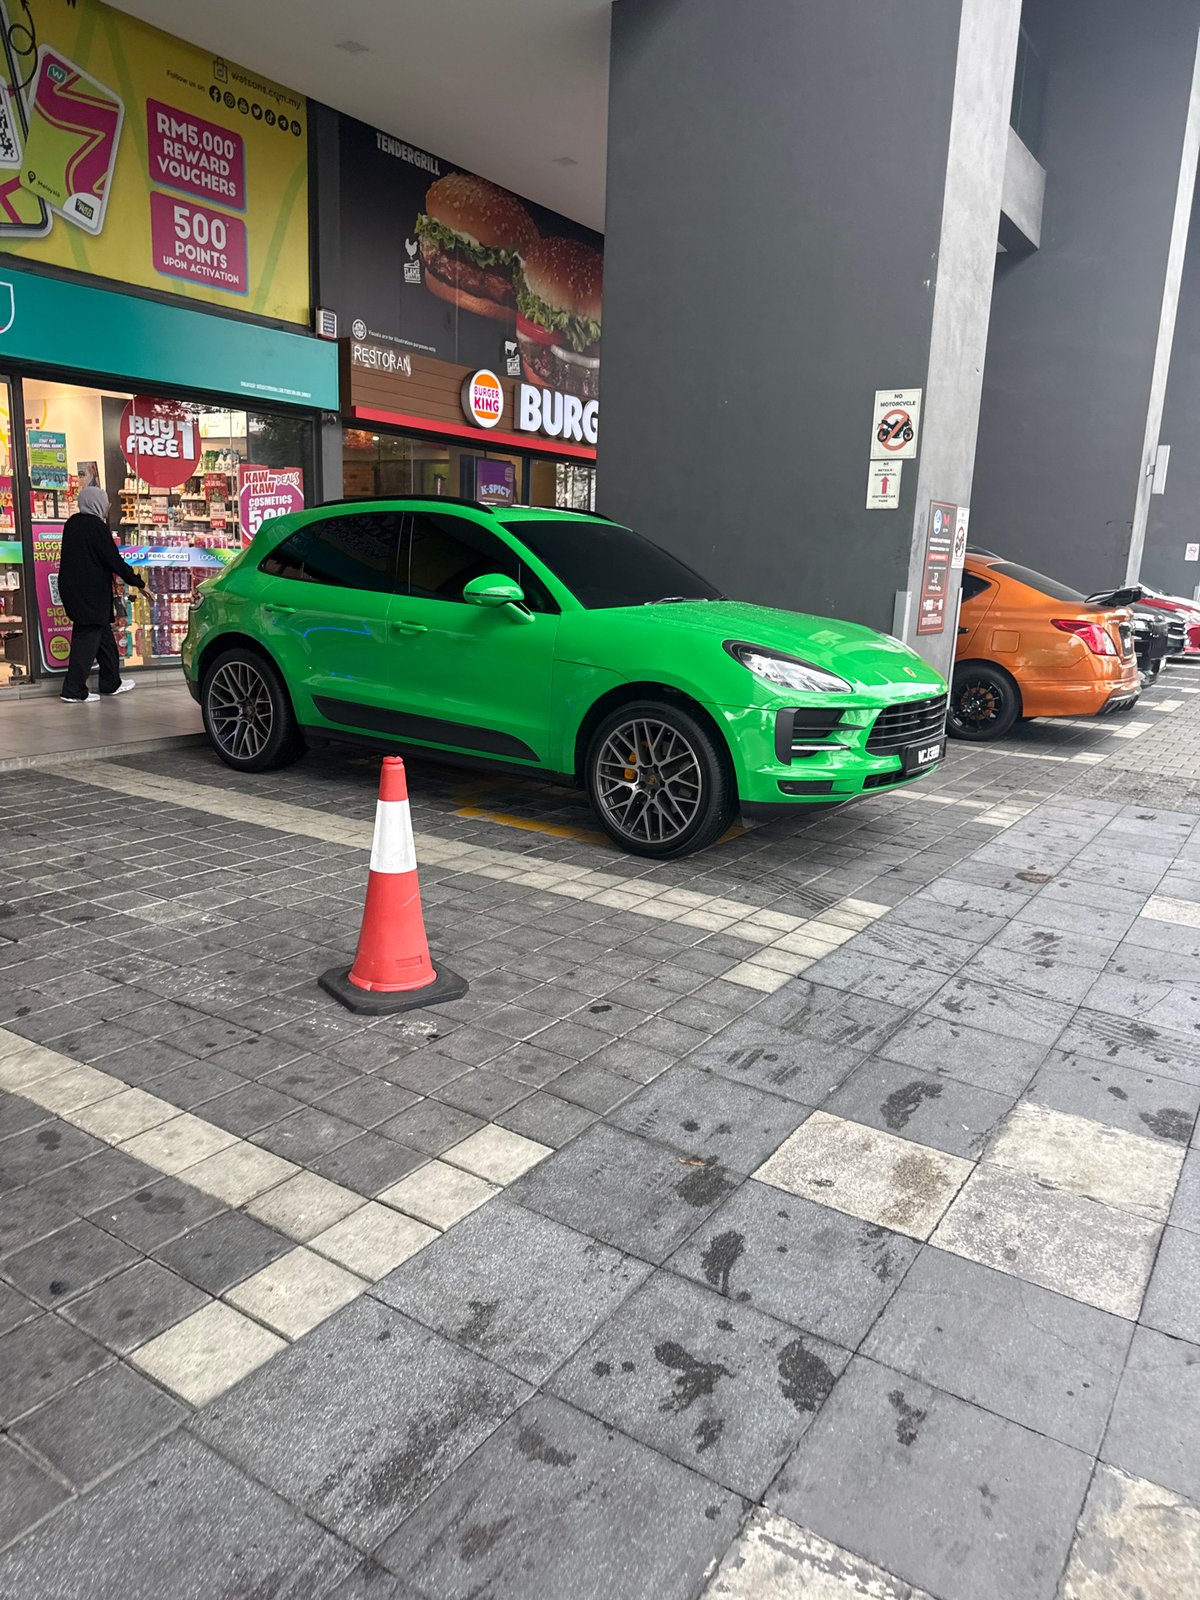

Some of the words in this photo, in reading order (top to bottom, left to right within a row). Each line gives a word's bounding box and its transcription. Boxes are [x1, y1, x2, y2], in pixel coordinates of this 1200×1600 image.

[166, 69, 188, 84] Follow
[189, 80, 196, 88] us
[197, 84, 206, 92] on
[231, 71, 302, 110] watsons.com.my
[163, 138, 229, 176] REWARD
[376, 132, 440, 176] TENDERGRILL
[37, 180, 60, 198] Malaysia
[157, 155, 236, 197] VOUCHERS
[174, 205, 227, 250] 500
[175, 240, 227, 269] POINTS
[163, 255, 187, 270] UPON
[190, 264, 239, 284] ACTIVATION
[354, 345, 411, 376] RESTORAN
[474, 386, 499, 399] BURGER
[474, 396, 499, 412] KING
[520, 383, 599, 444] BURG
[126, 435, 179, 458] FREE
[177, 421, 194, 460] 1
[245, 471, 269, 484] KAW
[276, 472, 299, 485] DEALS
[252, 482, 275, 495] KAW
[480, 484, 511, 498] K-SPICY
[249, 495, 293, 507] COSMETICS
